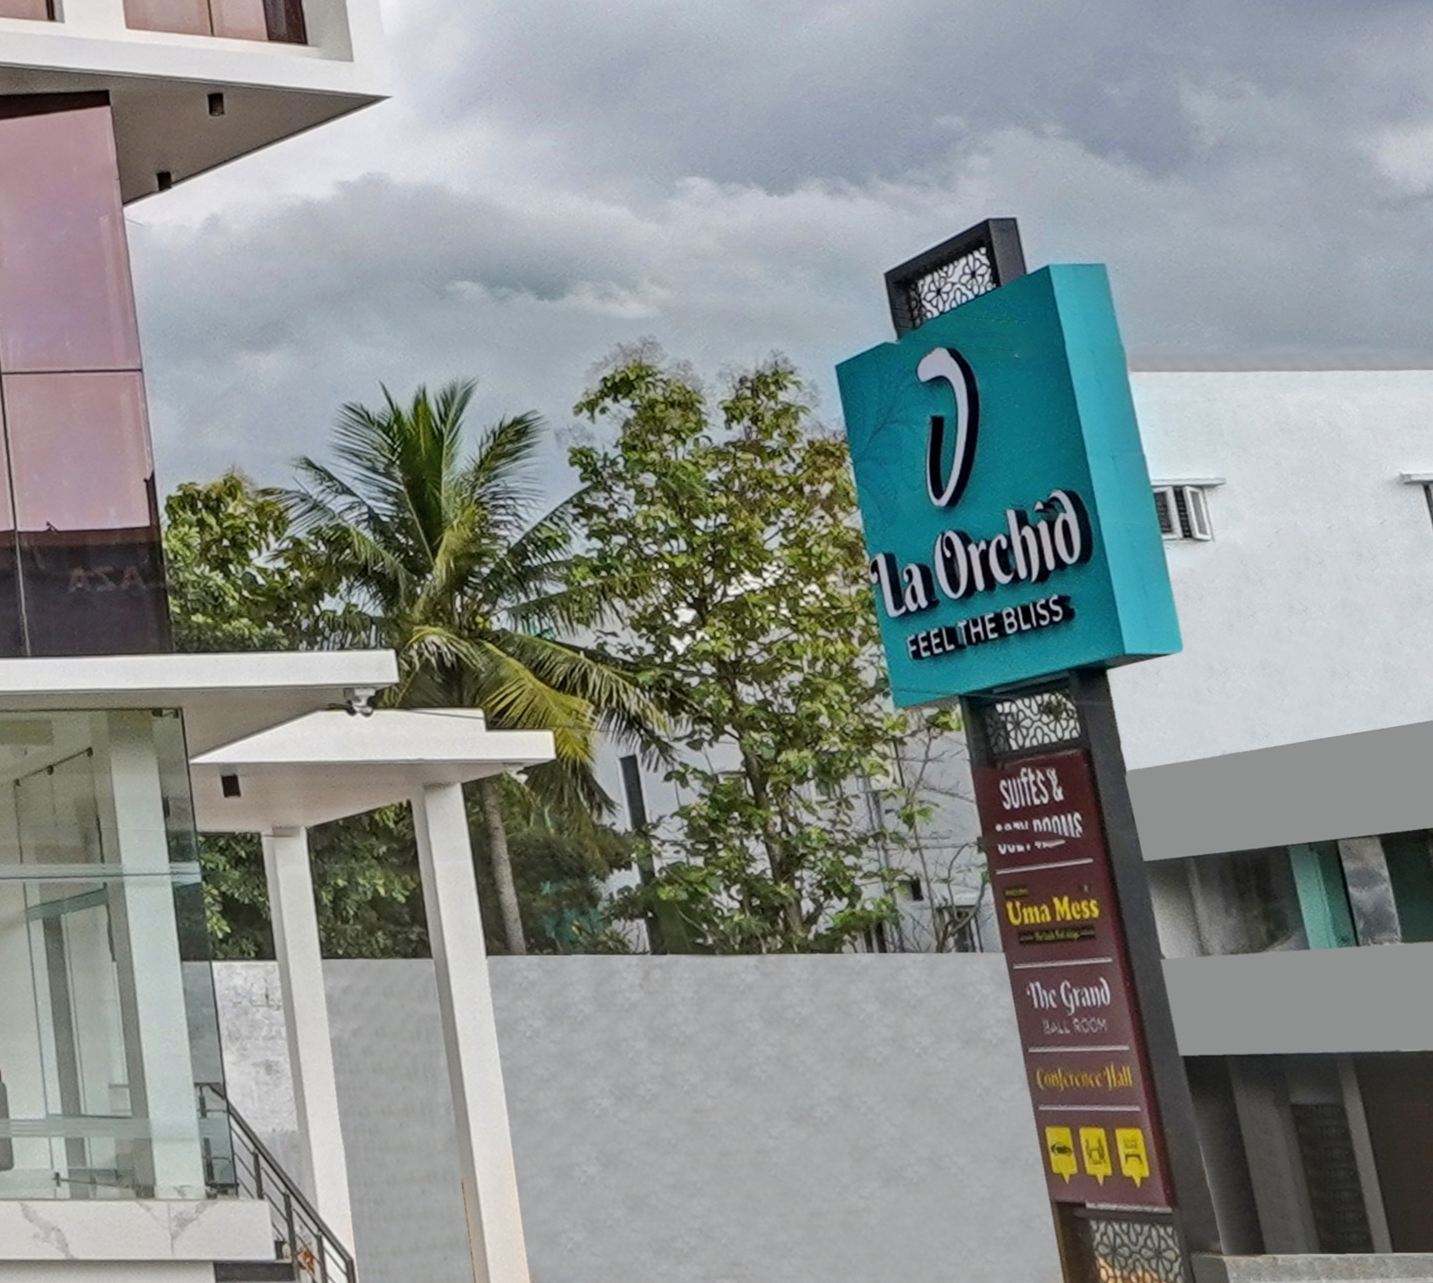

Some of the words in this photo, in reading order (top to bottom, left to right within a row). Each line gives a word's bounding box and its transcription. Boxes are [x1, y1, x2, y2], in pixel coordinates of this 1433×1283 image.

[870, 553, 929, 618] La
[935, 489, 1082, 600] Orchid
[907, 628, 956, 660] FEEL
[957, 614, 999, 646] THE
[1003, 594, 1064, 635] BLISS
[1006, 900, 1051, 926] Uma
[1052, 895, 1100, 922] Mess
[1026, 981, 1057, 1010] The
[1060, 976, 1111, 1016] Grand
